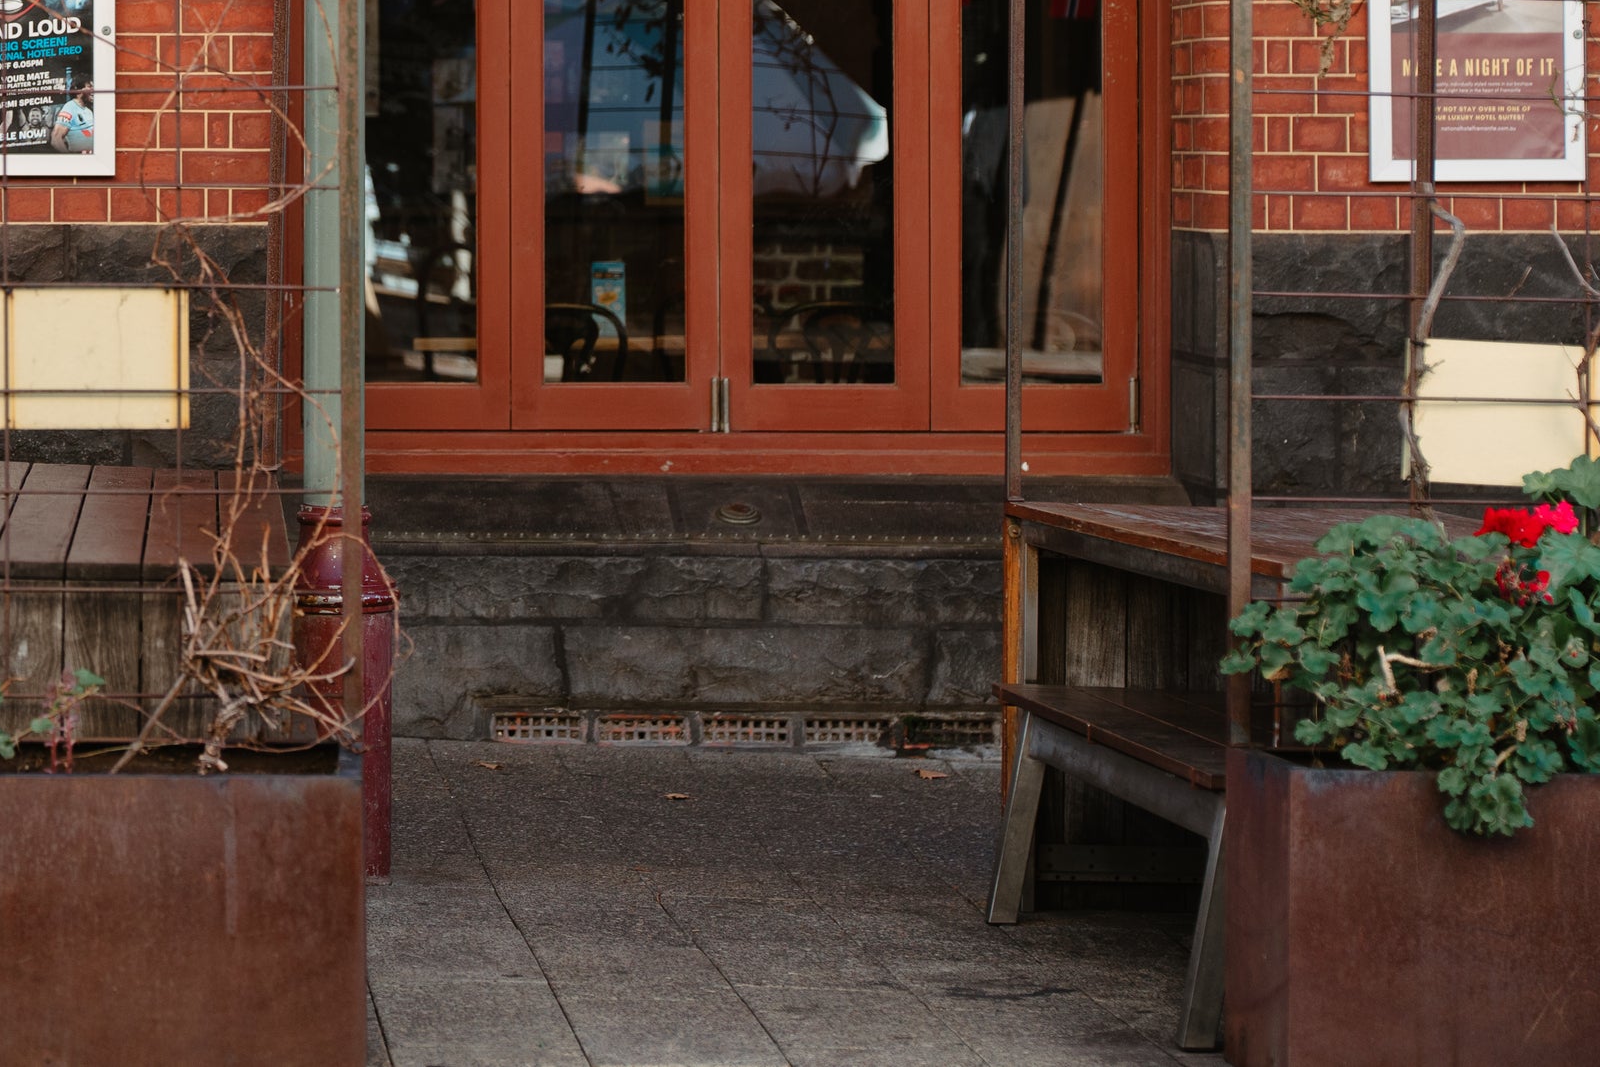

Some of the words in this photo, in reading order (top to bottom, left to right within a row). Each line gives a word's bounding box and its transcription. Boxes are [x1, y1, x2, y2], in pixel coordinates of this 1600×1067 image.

[28, 17, 81, 37] LOUD
[1, 41, 18, 52] BIG
[22, 36, 68, 50] SCREEN!
[27, 49, 56, 59] HOTEL
[59, 46, 83, 56] FREO
[13, 59, 43, 69] 6.05PM
[1450, 58, 1458, 76] A
[1465, 58, 1510, 76] NIGHT
[1516, 58, 1533, 76] OF
[1540, 58, 1554, 76] IT
[27, 71, 50, 80] MATE
[19, 96, 54, 106] SPECIAL
[19, 129, 46, 140] NOW!
